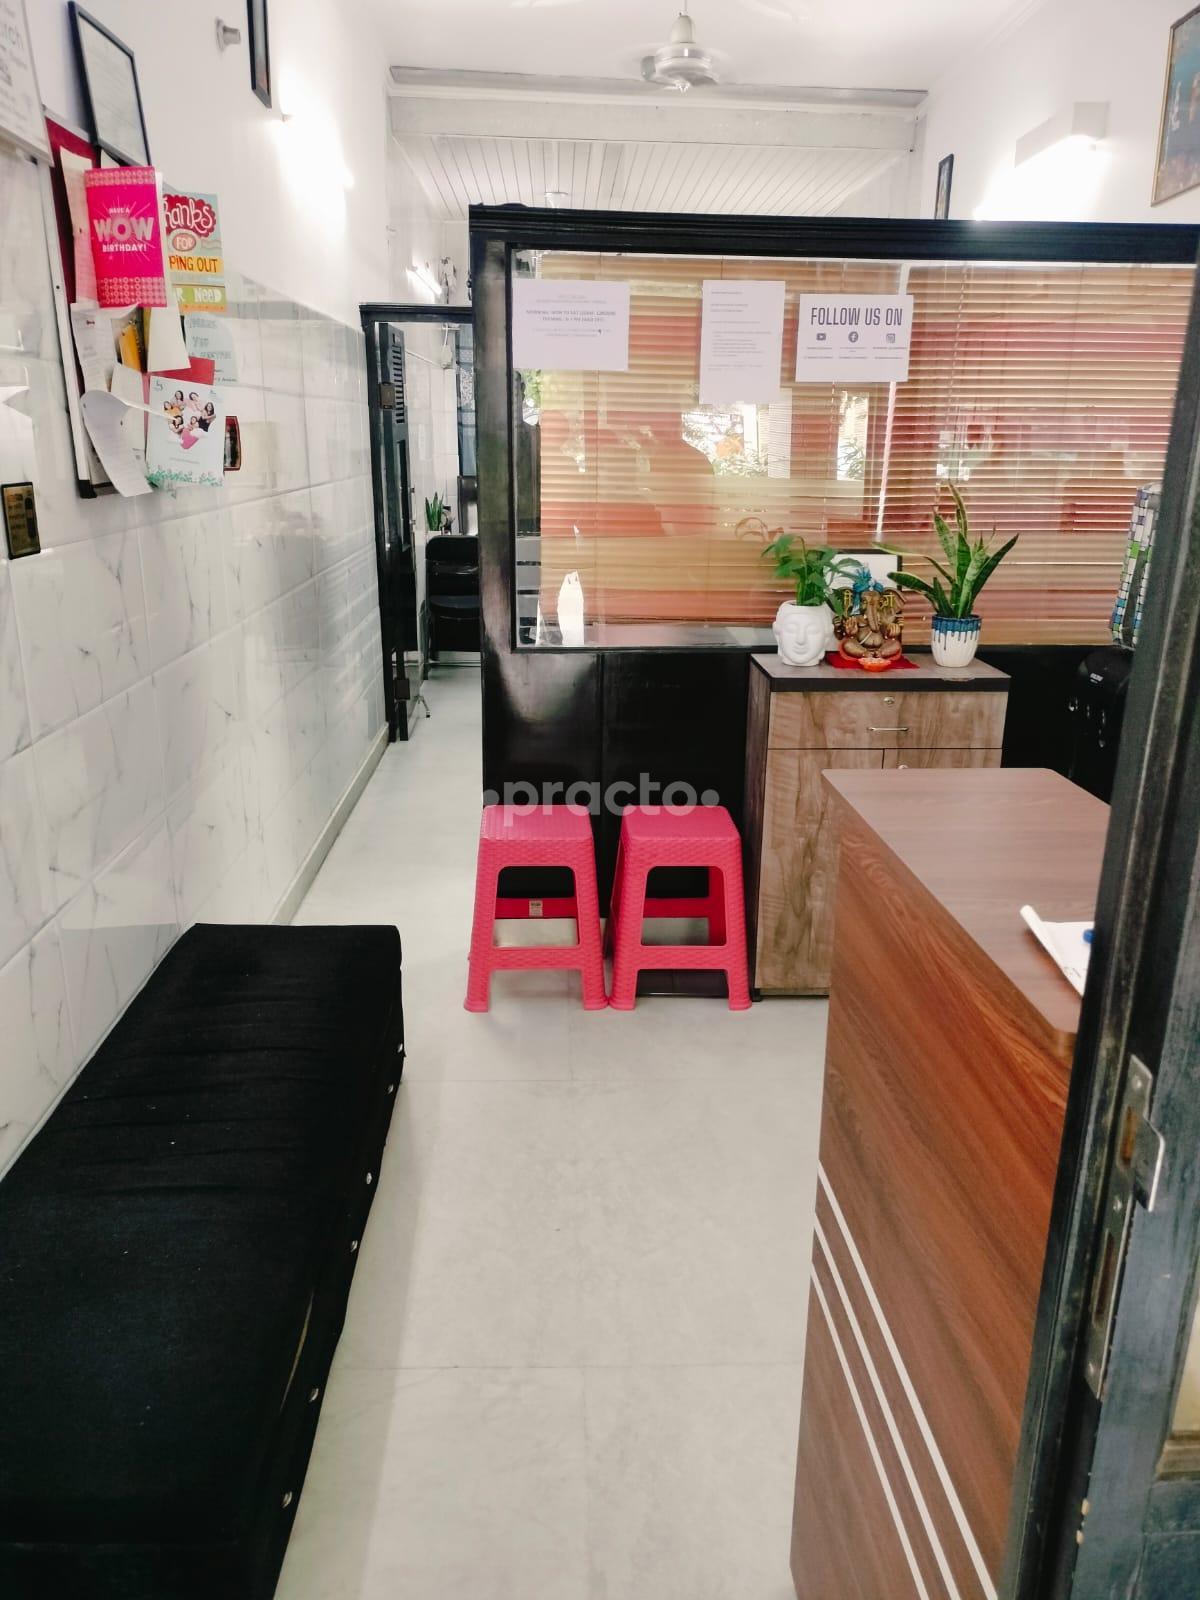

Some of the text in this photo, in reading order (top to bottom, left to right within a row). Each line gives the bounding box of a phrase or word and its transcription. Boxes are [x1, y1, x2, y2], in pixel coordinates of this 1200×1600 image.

[164, 197, 213, 233] hanks
[94, 217, 154, 242] WOW
[102, 244, 147, 252] BIRTHDAY!
[176, 236, 195, 249] FOR
[196, 257, 218, 272] OUT
[811, 307, 902, 326] FOLLOW US ON
